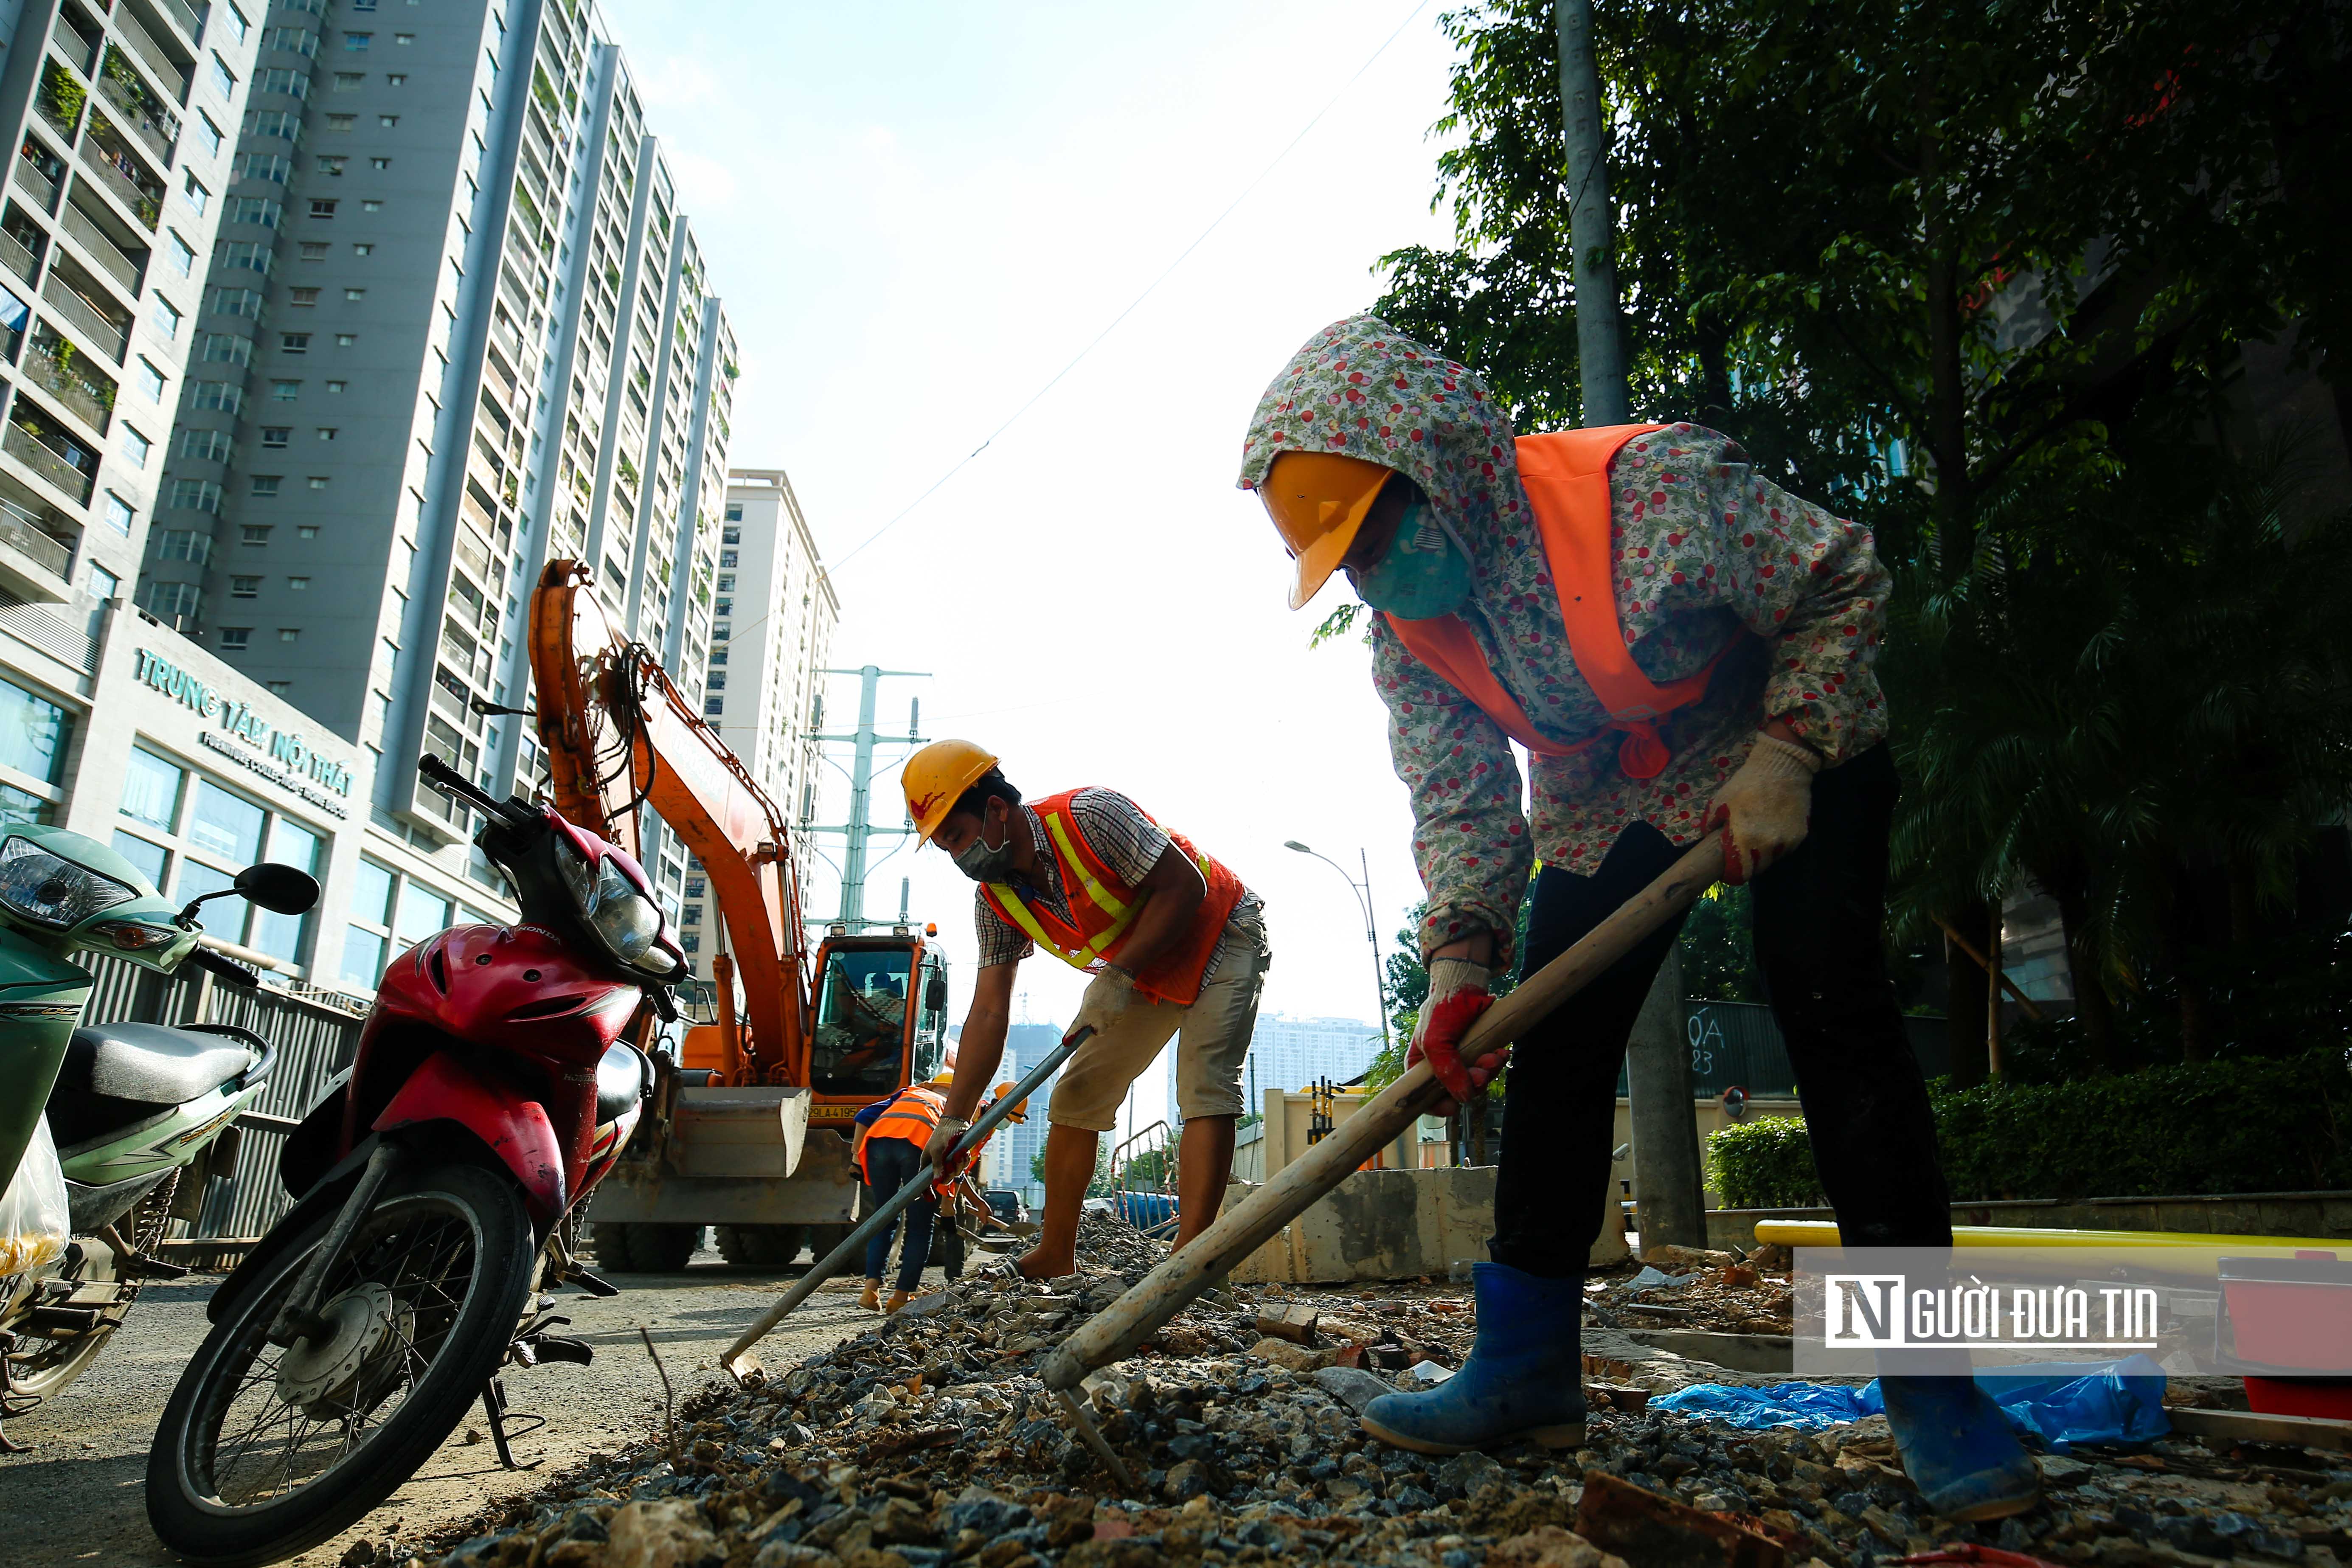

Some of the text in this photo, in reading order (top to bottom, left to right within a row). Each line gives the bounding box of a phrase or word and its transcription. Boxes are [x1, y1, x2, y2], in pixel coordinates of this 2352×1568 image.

[139, 645, 356, 798] TRUNG TÂM NỘI THẤT
[203, 732, 250, 769] FURNITURE
[250, 758, 299, 793] COLLECTION
[517, 926, 562, 946] HONDA
[1692, 1049, 1712, 1074] 83
